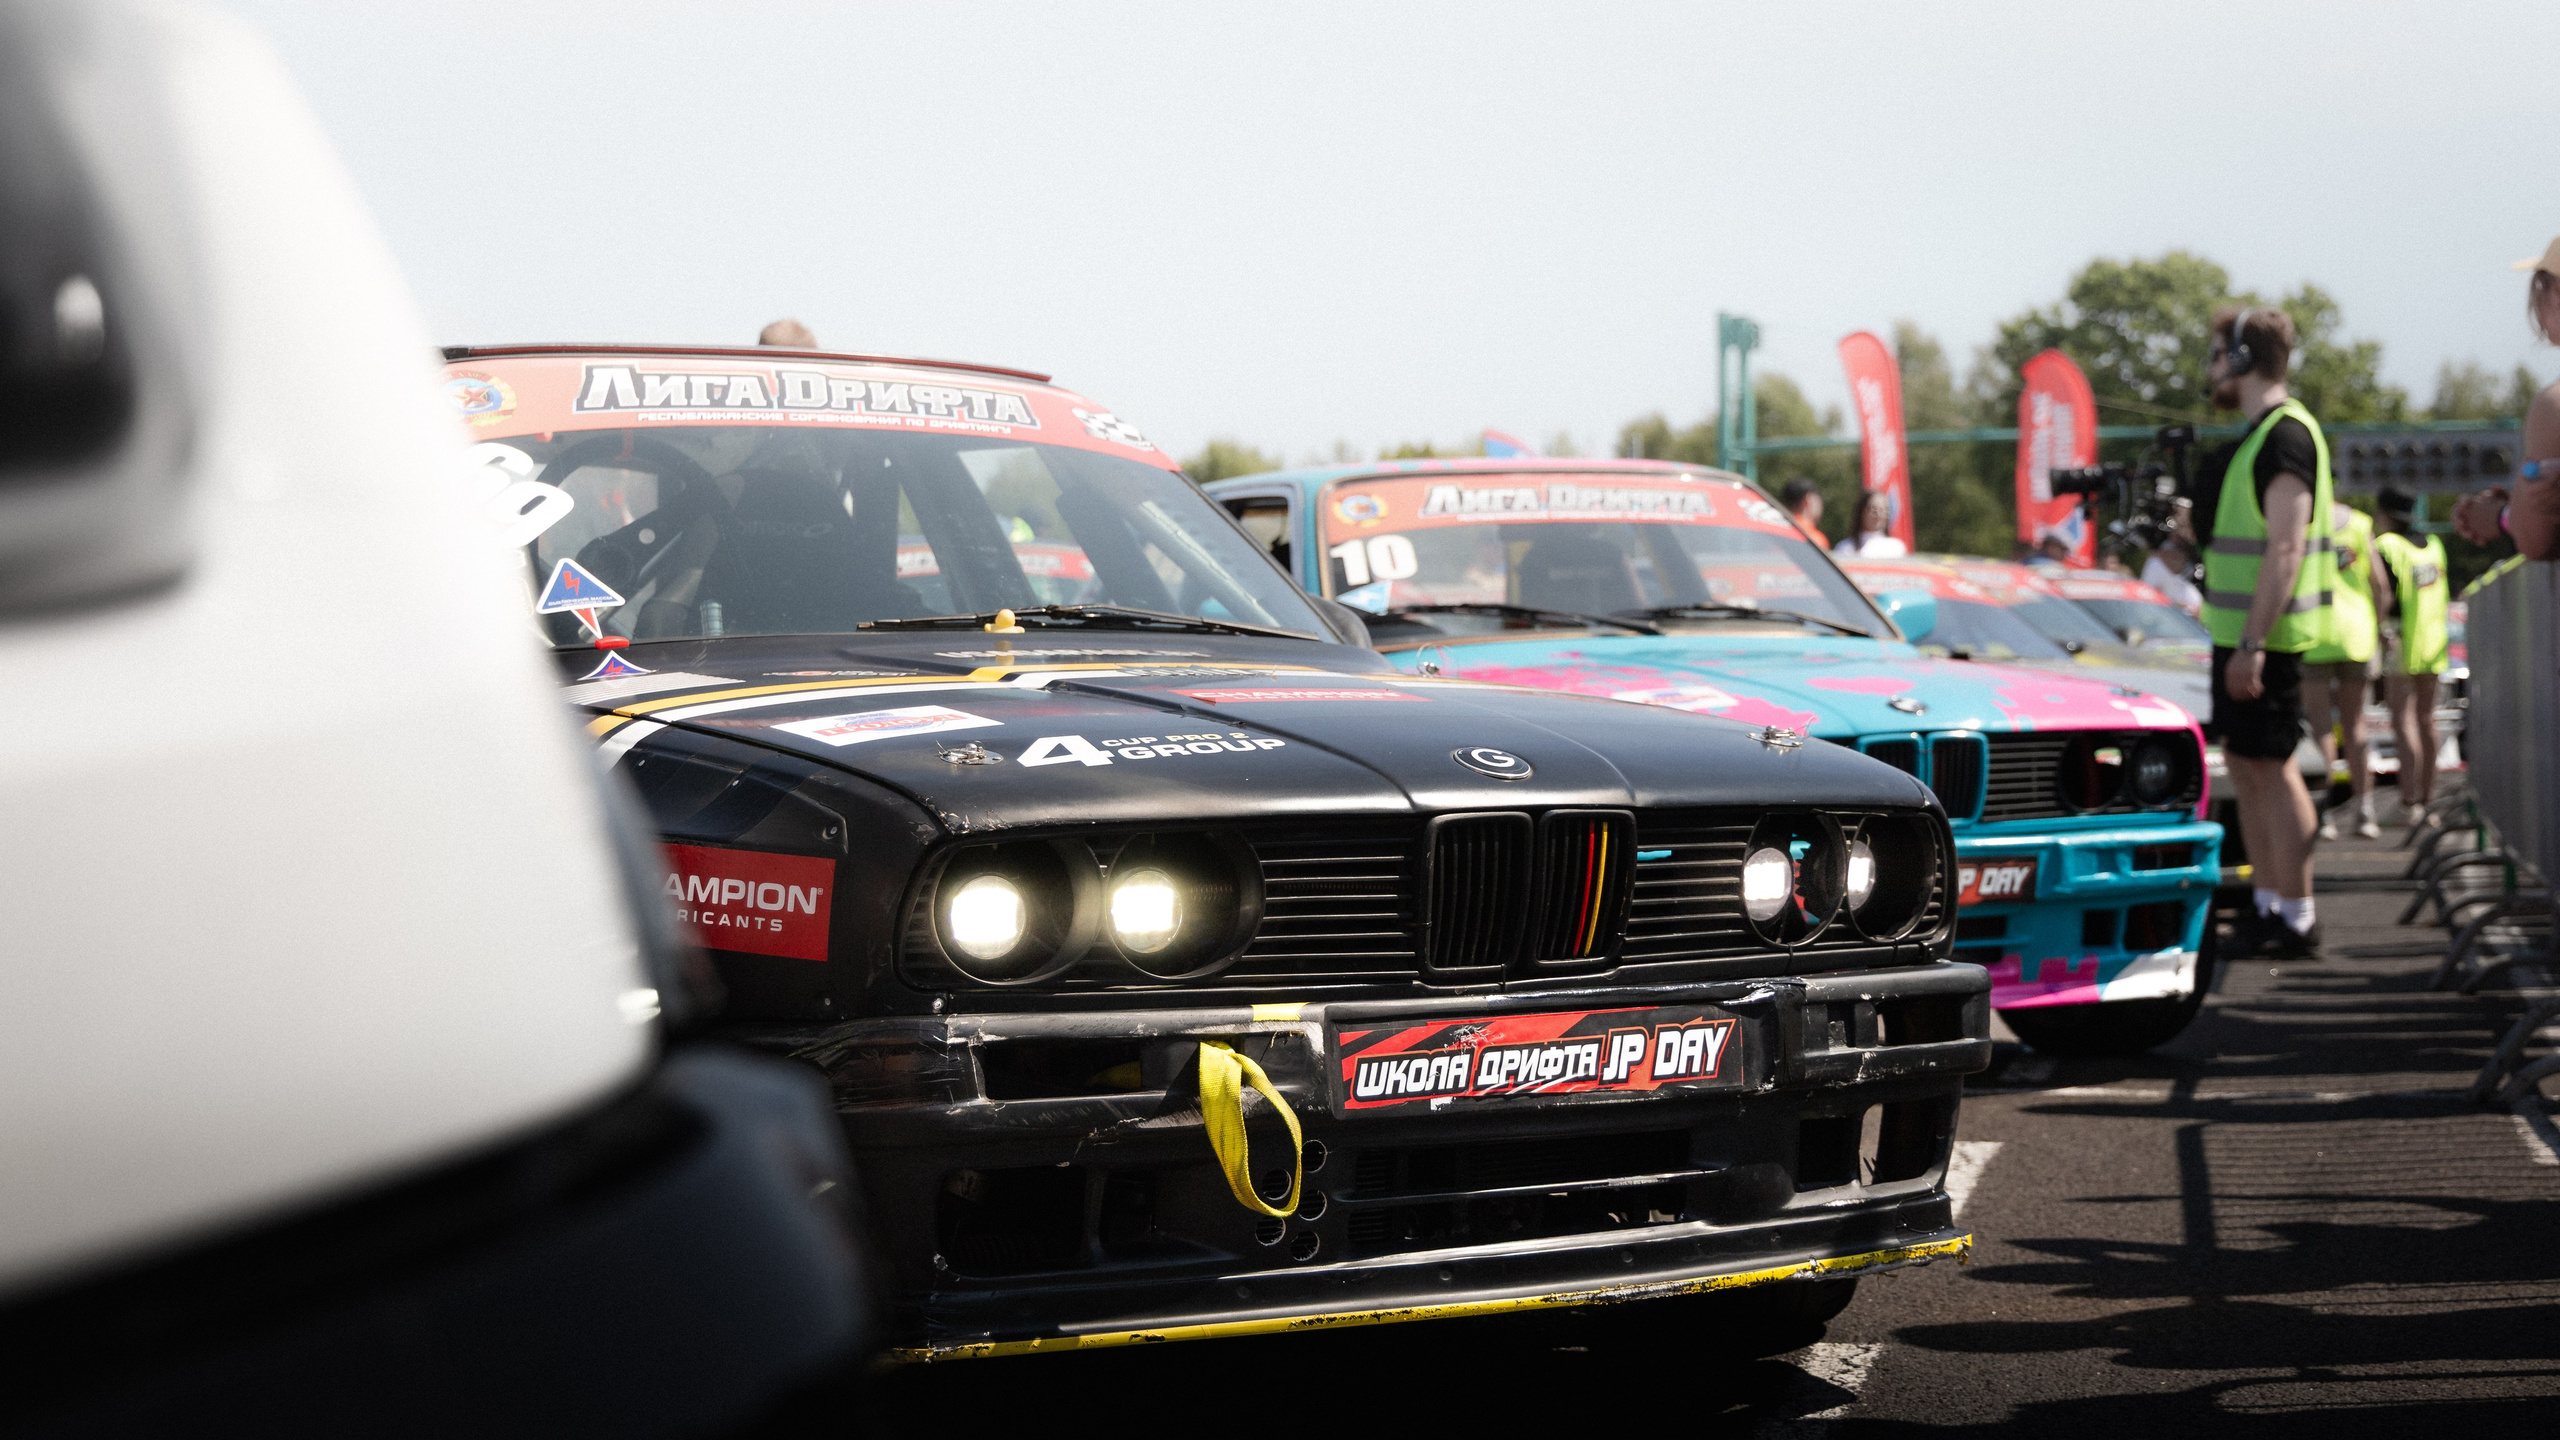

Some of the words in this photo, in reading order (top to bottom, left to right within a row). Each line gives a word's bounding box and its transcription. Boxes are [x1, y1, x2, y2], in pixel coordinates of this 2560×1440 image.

[580, 367, 768, 409] ЛИГА
[1329, 534, 1419, 586] 10
[1017, 735, 1115, 767] 4
[1101, 736, 1158, 747] CUP
[1164, 733, 1223, 742] PRO
[1117, 738, 1286, 760] GROUP
[1470, 748, 1515, 767] G
[1958, 867, 1977, 895] P
[1978, 866, 2031, 895] DAY
[677, 909, 783, 931] RICANTS
[1355, 1053, 1470, 1098] ШКОЛА
[1477, 1043, 1600, 1087] ДРИФТА
[1602, 1033, 1647, 1081] JP
[1654, 1026, 1729, 1075] DAY
